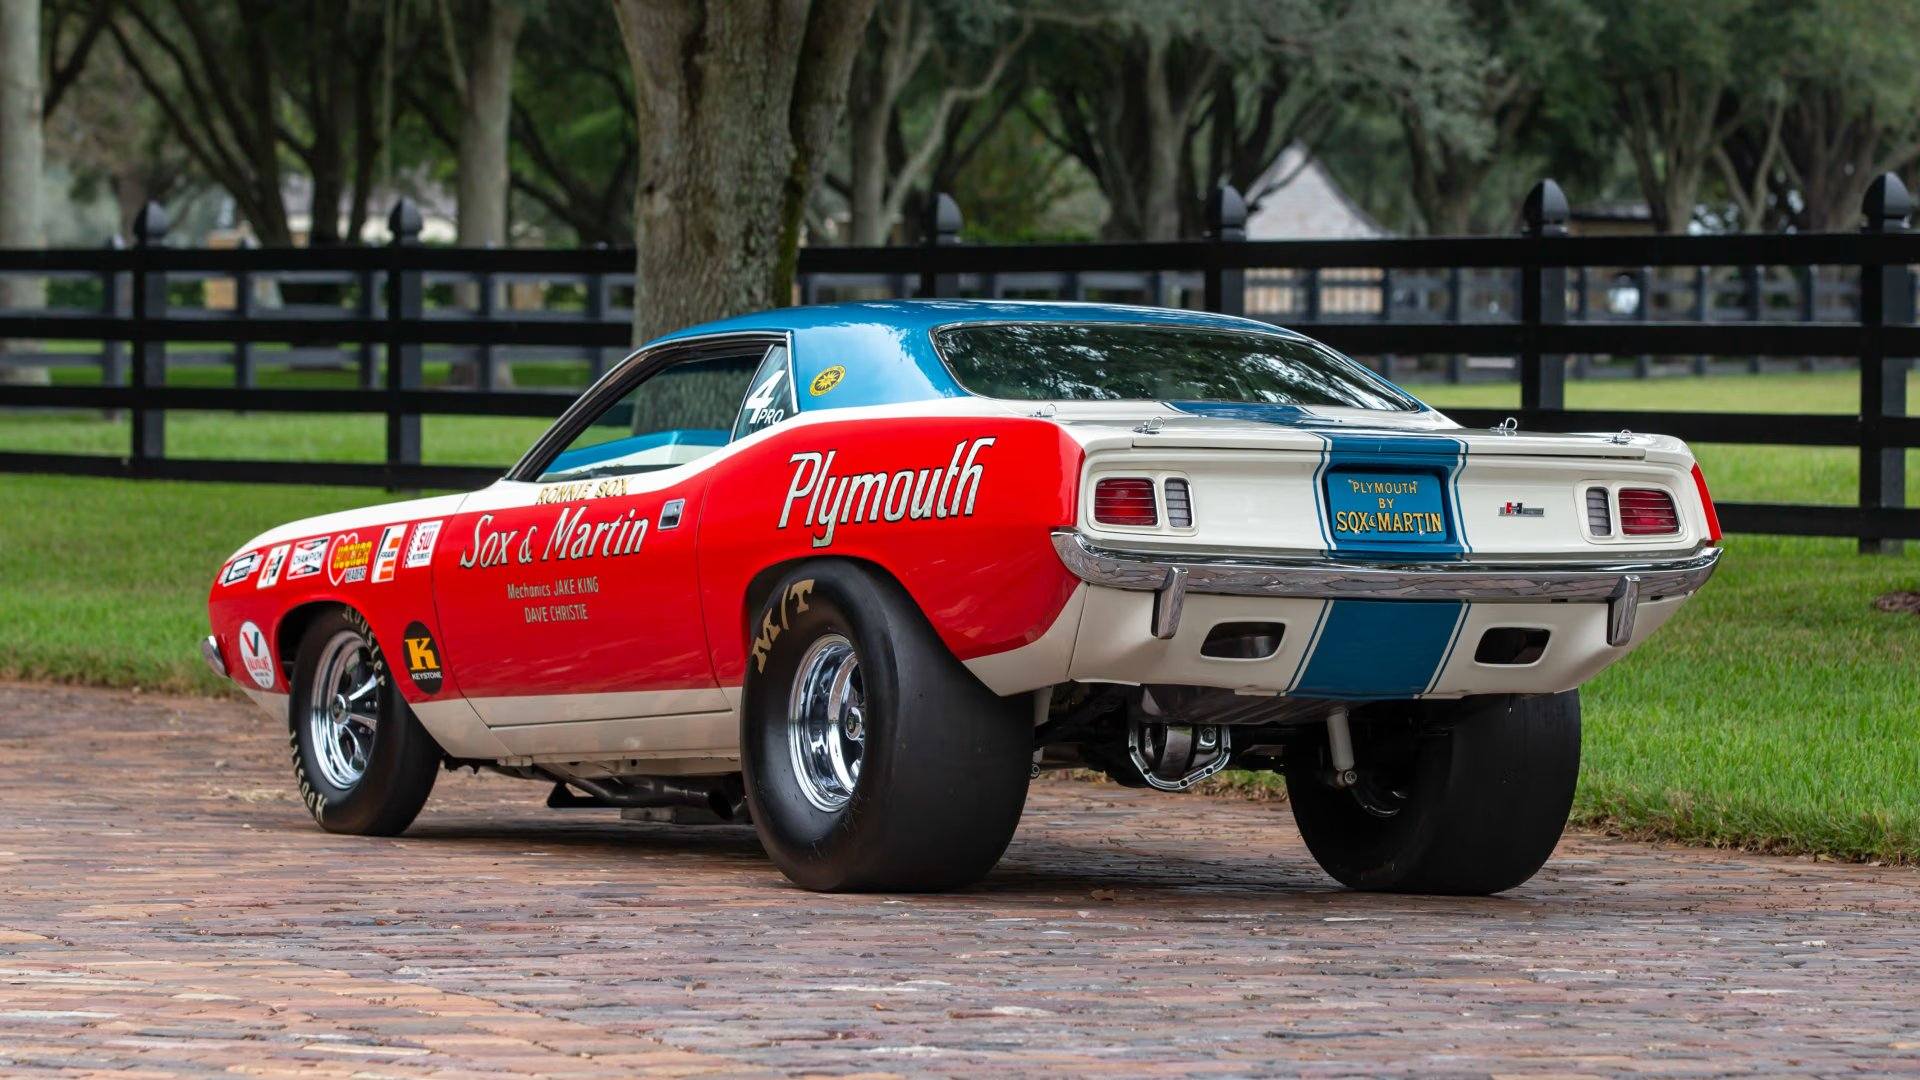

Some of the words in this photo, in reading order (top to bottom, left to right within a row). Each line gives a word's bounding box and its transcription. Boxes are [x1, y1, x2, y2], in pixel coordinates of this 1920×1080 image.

[745, 370, 785, 424] 4
[757, 409, 784, 425] PRO
[536, 484, 592, 505] RONNIE
[777, 436, 997, 548] Plymouth
[1378, 497, 1394, 509] BY
[460, 514, 518, 568] Sox
[518, 525, 538, 564] &
[541, 505, 649, 560] Martin
[507, 583, 551, 600] Mechanics
[554, 579, 577, 597] JAKE
[578, 576, 599, 593] KING
[524, 606, 548, 624] DAVE
[550, 603, 588, 622] CHRISTIE
[752, 579, 815, 674] M/T
[404, 637, 440, 670] K
[412, 671, 443, 680] KEYSTONE
